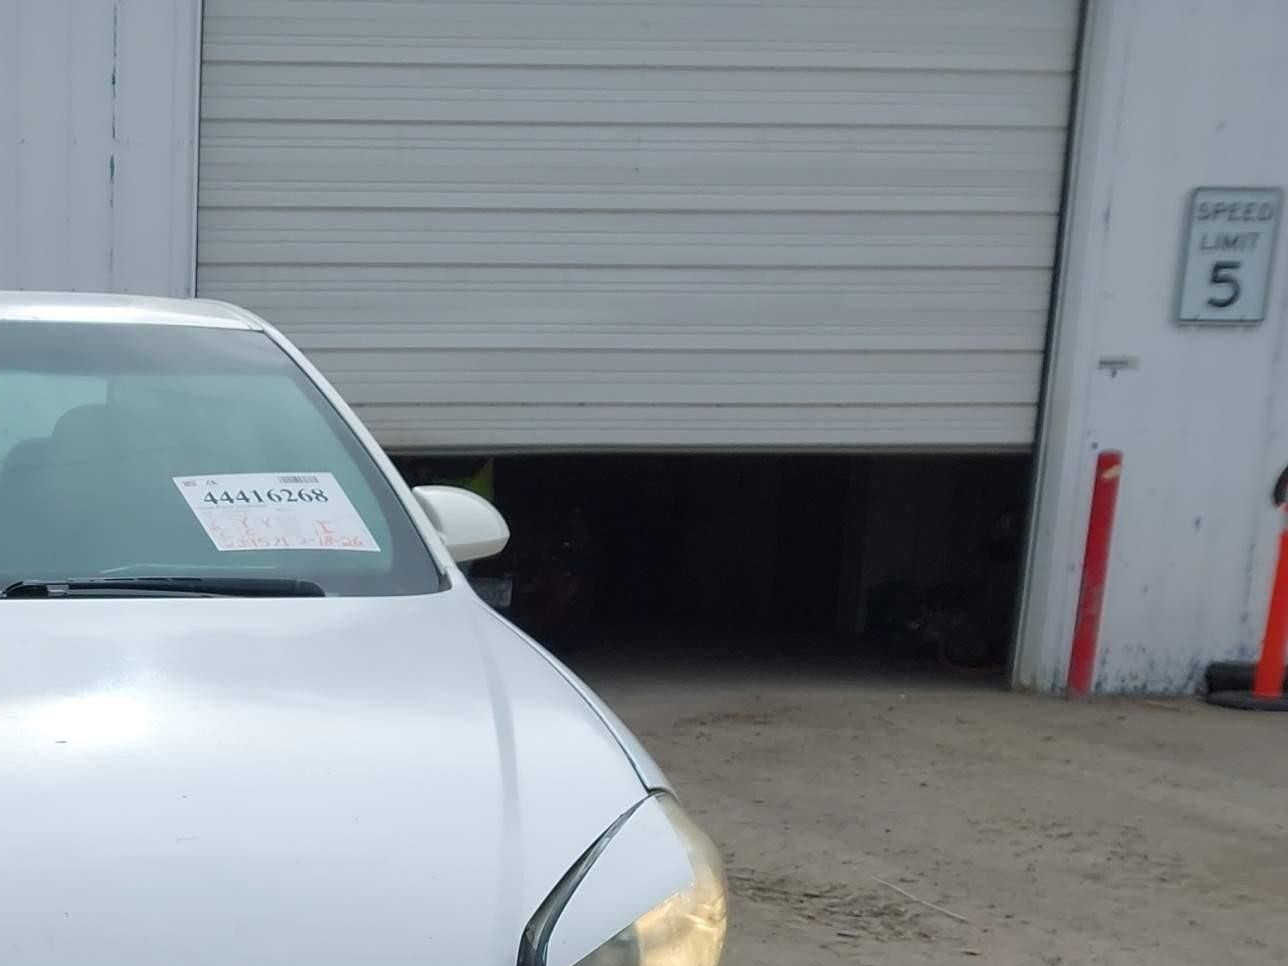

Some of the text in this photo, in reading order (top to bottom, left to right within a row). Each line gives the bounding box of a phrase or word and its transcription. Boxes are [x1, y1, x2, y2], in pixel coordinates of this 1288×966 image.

[1197, 201, 1273, 222] SPEED
[1200, 232, 1260, 250] LIMIT
[1207, 261, 1242, 308] 5
[204, 488, 328, 504] 44416268
